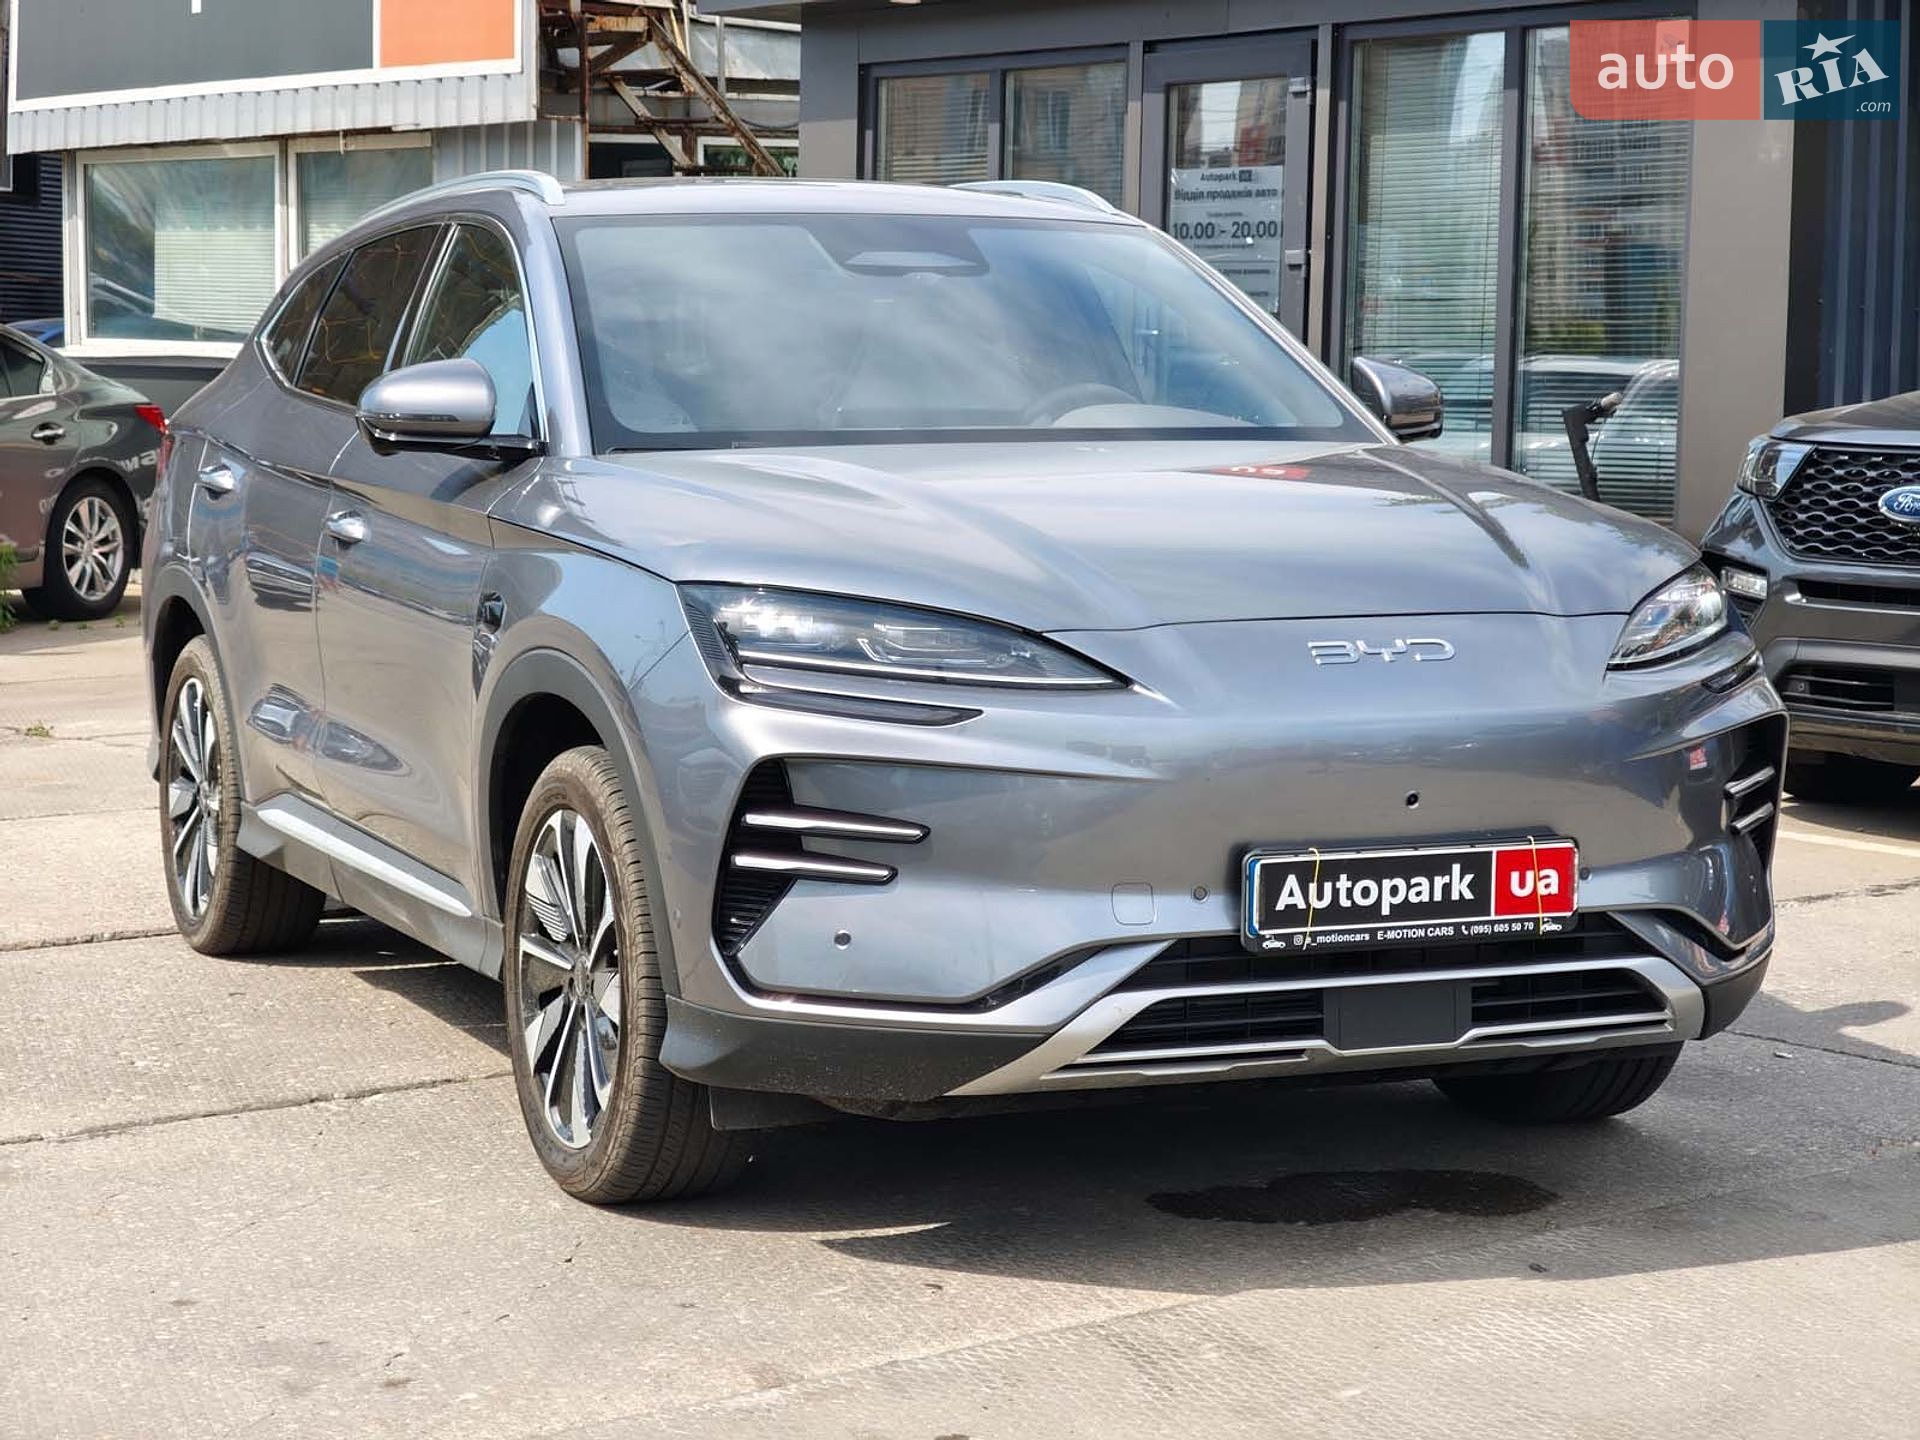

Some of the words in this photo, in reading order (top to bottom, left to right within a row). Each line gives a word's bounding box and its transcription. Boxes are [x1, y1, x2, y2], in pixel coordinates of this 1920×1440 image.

[1200, 171, 1239, 183] Autopark
[1174, 188, 1205, 202] Відділ
[1255, 188, 1278, 198] авто
[1173, 221, 1215, 240] 10.00
[1231, 220, 1278, 239] 20.00
[1307, 638, 1455, 665] BYD
[1275, 863, 1475, 916] Autopark
[1509, 868, 1560, 898] ua
[1377, 927, 1425, 940] E-MOTION
[1427, 926, 1455, 937] CARS
[1470, 924, 1492, 935] (095)
[1494, 923, 1510, 933] 605
[1511, 922, 1521, 931] 50
[1524, 921, 1534, 930] 70
